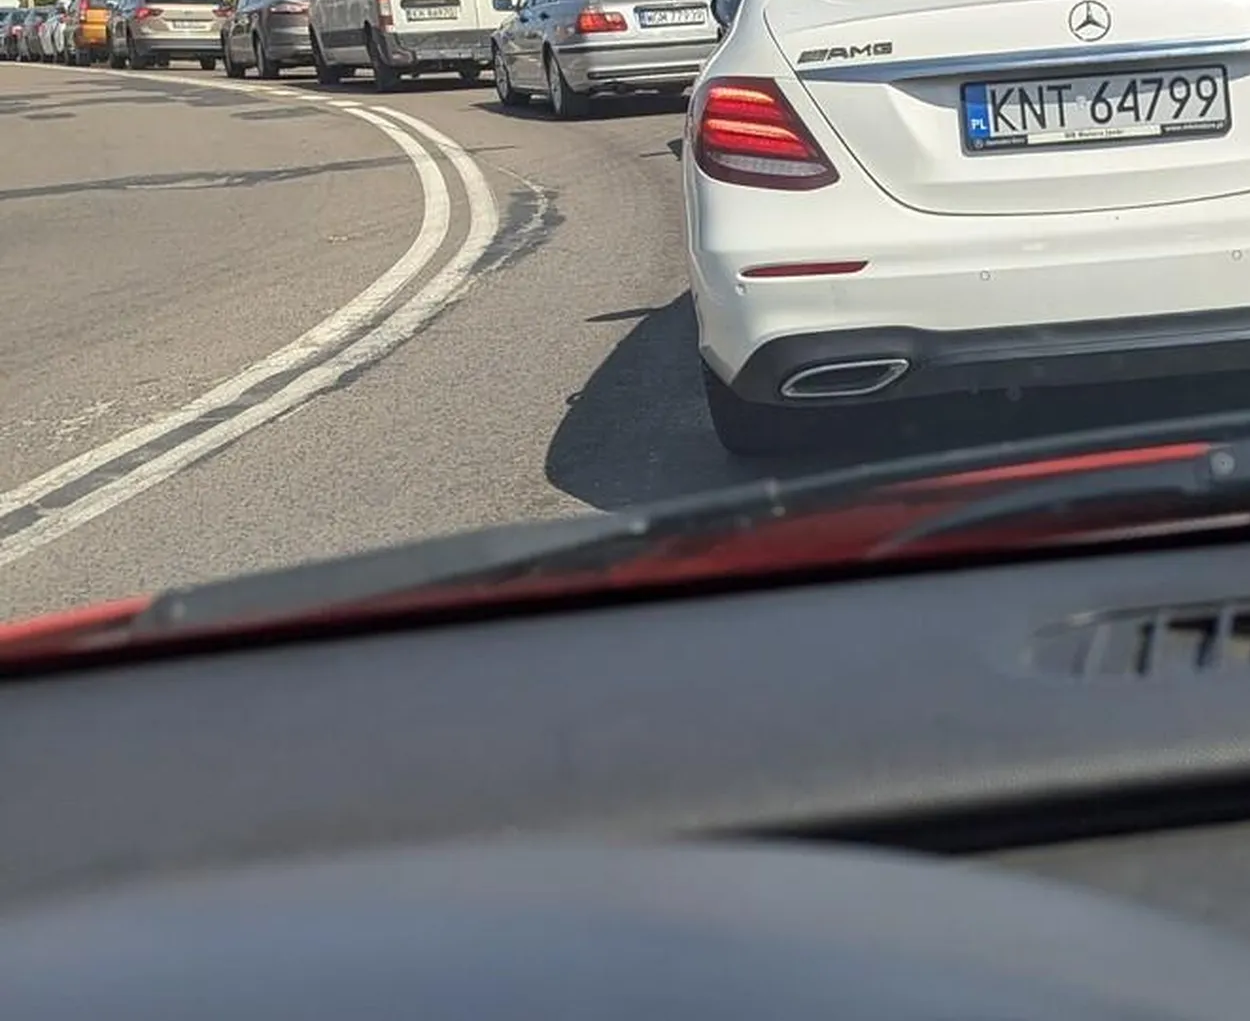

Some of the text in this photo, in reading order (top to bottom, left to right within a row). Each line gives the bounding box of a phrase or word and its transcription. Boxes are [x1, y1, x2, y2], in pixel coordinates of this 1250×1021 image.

[826, 42, 893, 61] AMG
[990, 74, 1219, 134] KNT 64799
[971, 119, 987, 130] PL
